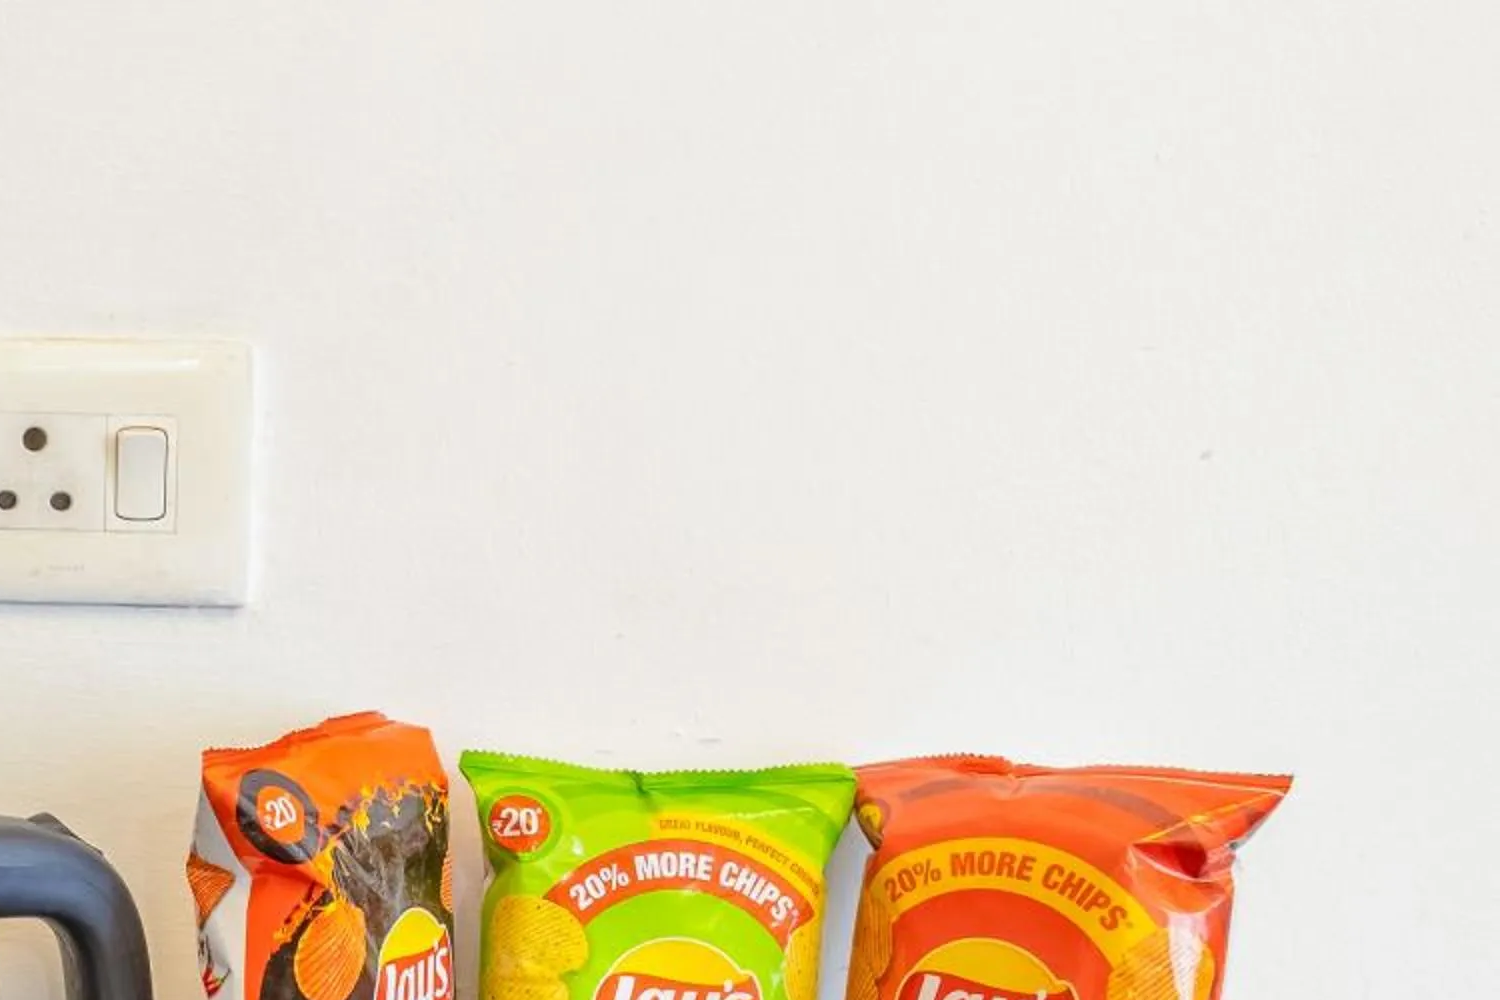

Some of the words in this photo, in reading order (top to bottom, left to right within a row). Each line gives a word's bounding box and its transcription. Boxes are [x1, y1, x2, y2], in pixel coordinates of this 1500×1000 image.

[568, 863, 629, 911] 20%
[634, 851, 715, 881] MORE
[884, 859, 943, 904] 20%
[950, 850, 1038, 883] MORE
